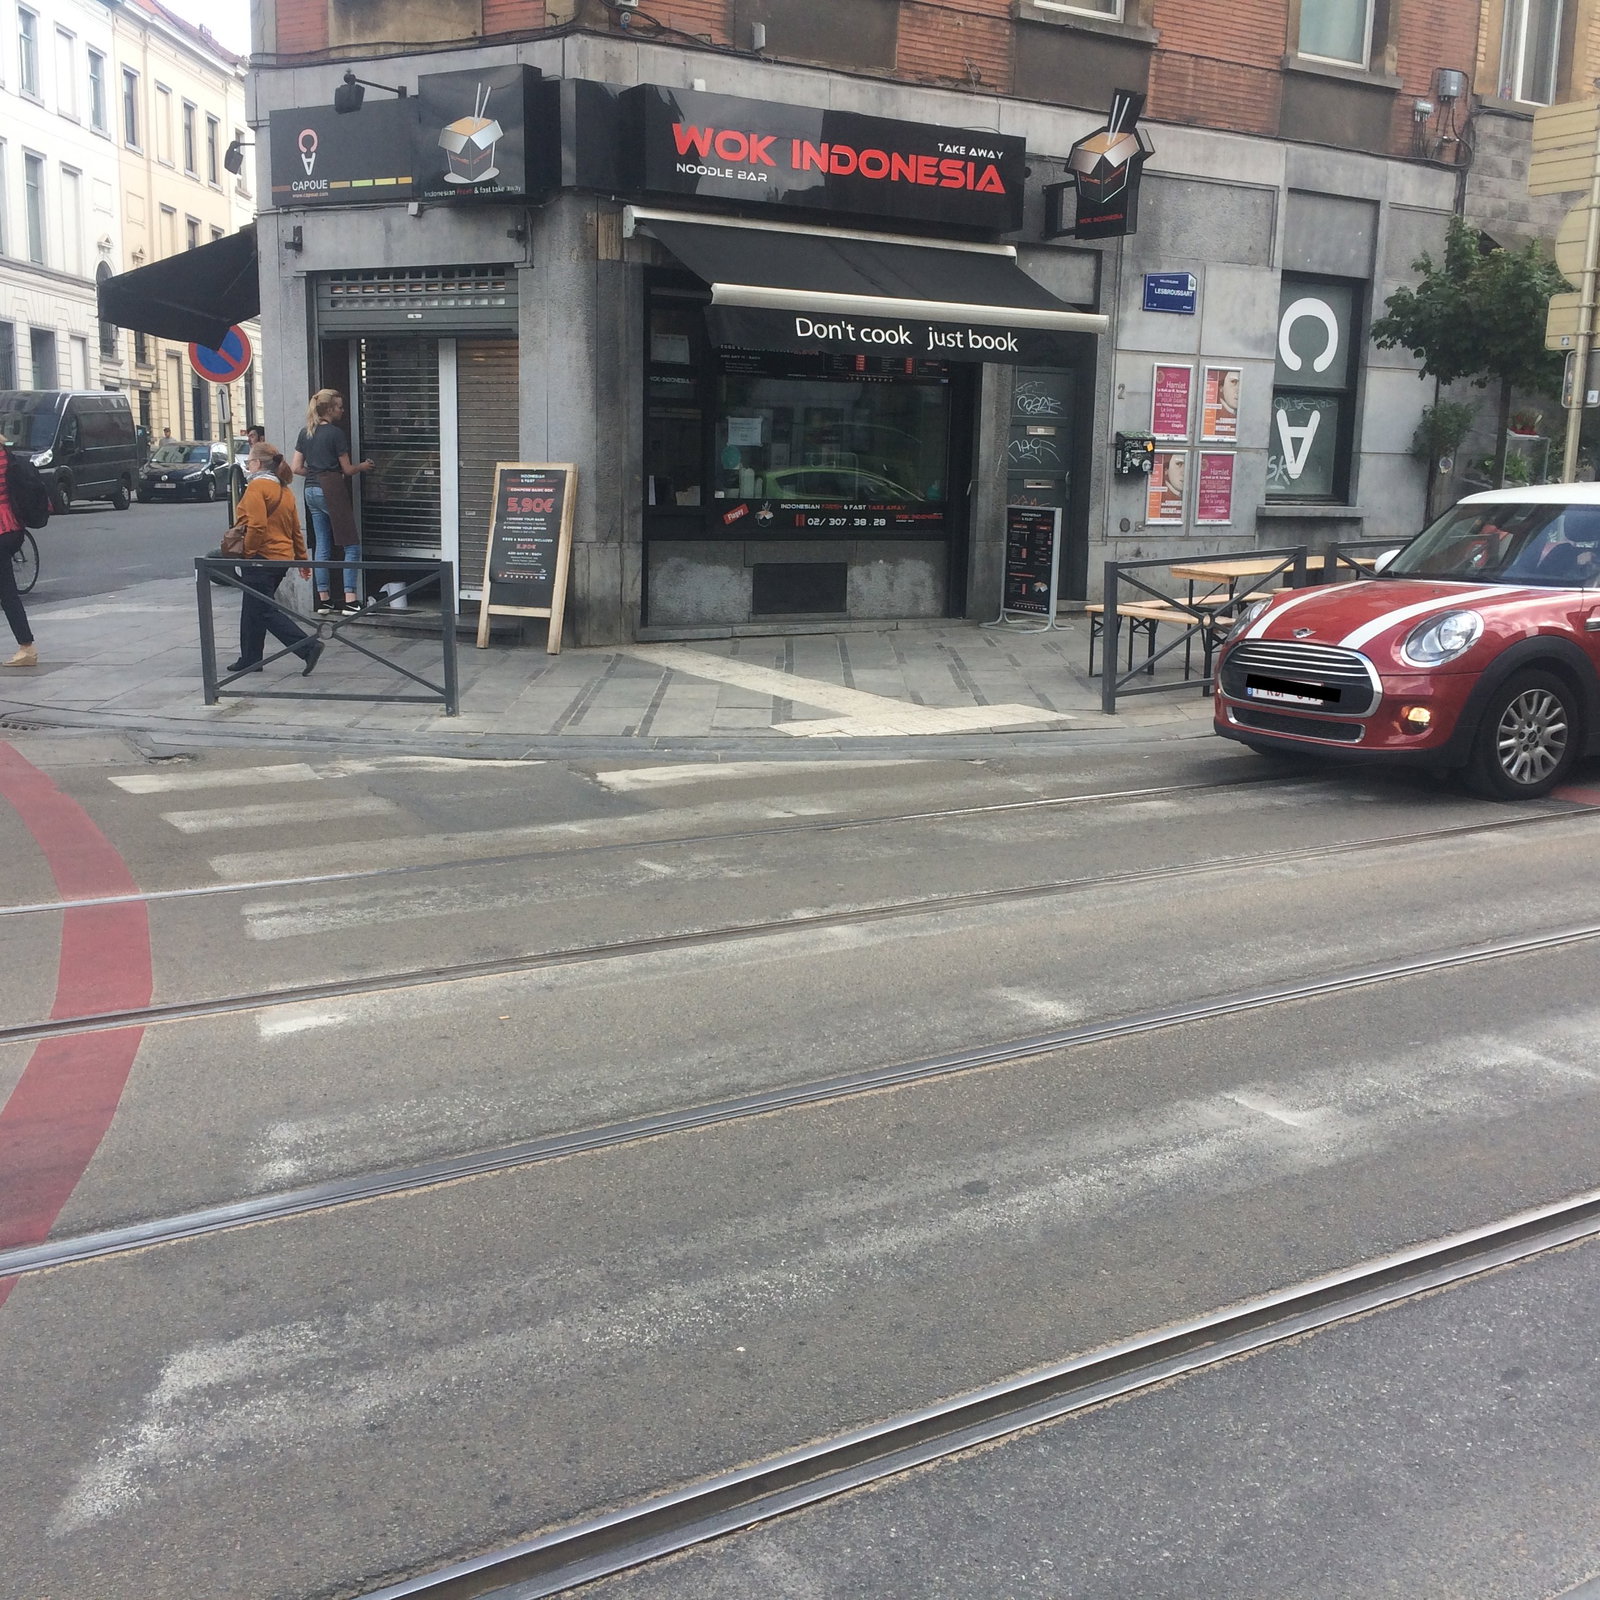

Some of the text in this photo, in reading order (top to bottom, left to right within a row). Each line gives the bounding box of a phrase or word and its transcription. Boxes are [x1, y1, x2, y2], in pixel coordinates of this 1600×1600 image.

[672, 122, 1006, 194] WOK INDONESIA
[938, 142, 1004, 160] TAKE AWAY
[676, 162, 768, 182] NOODLE BAR
[291, 179, 328, 191] CAPOUE
[424, 189, 456, 198] Indonesian
[479, 186, 491, 194] fast
[1154, 287, 1194, 298] LESBROUSSART
[795, 317, 1019, 353] Don't cook just book
[1117, 383, 1127, 400] 2
[1166, 381, 1187, 390] Hamlet
[507, 497, 555, 514] 5,90€
[829, 518, 847, 526] 307
